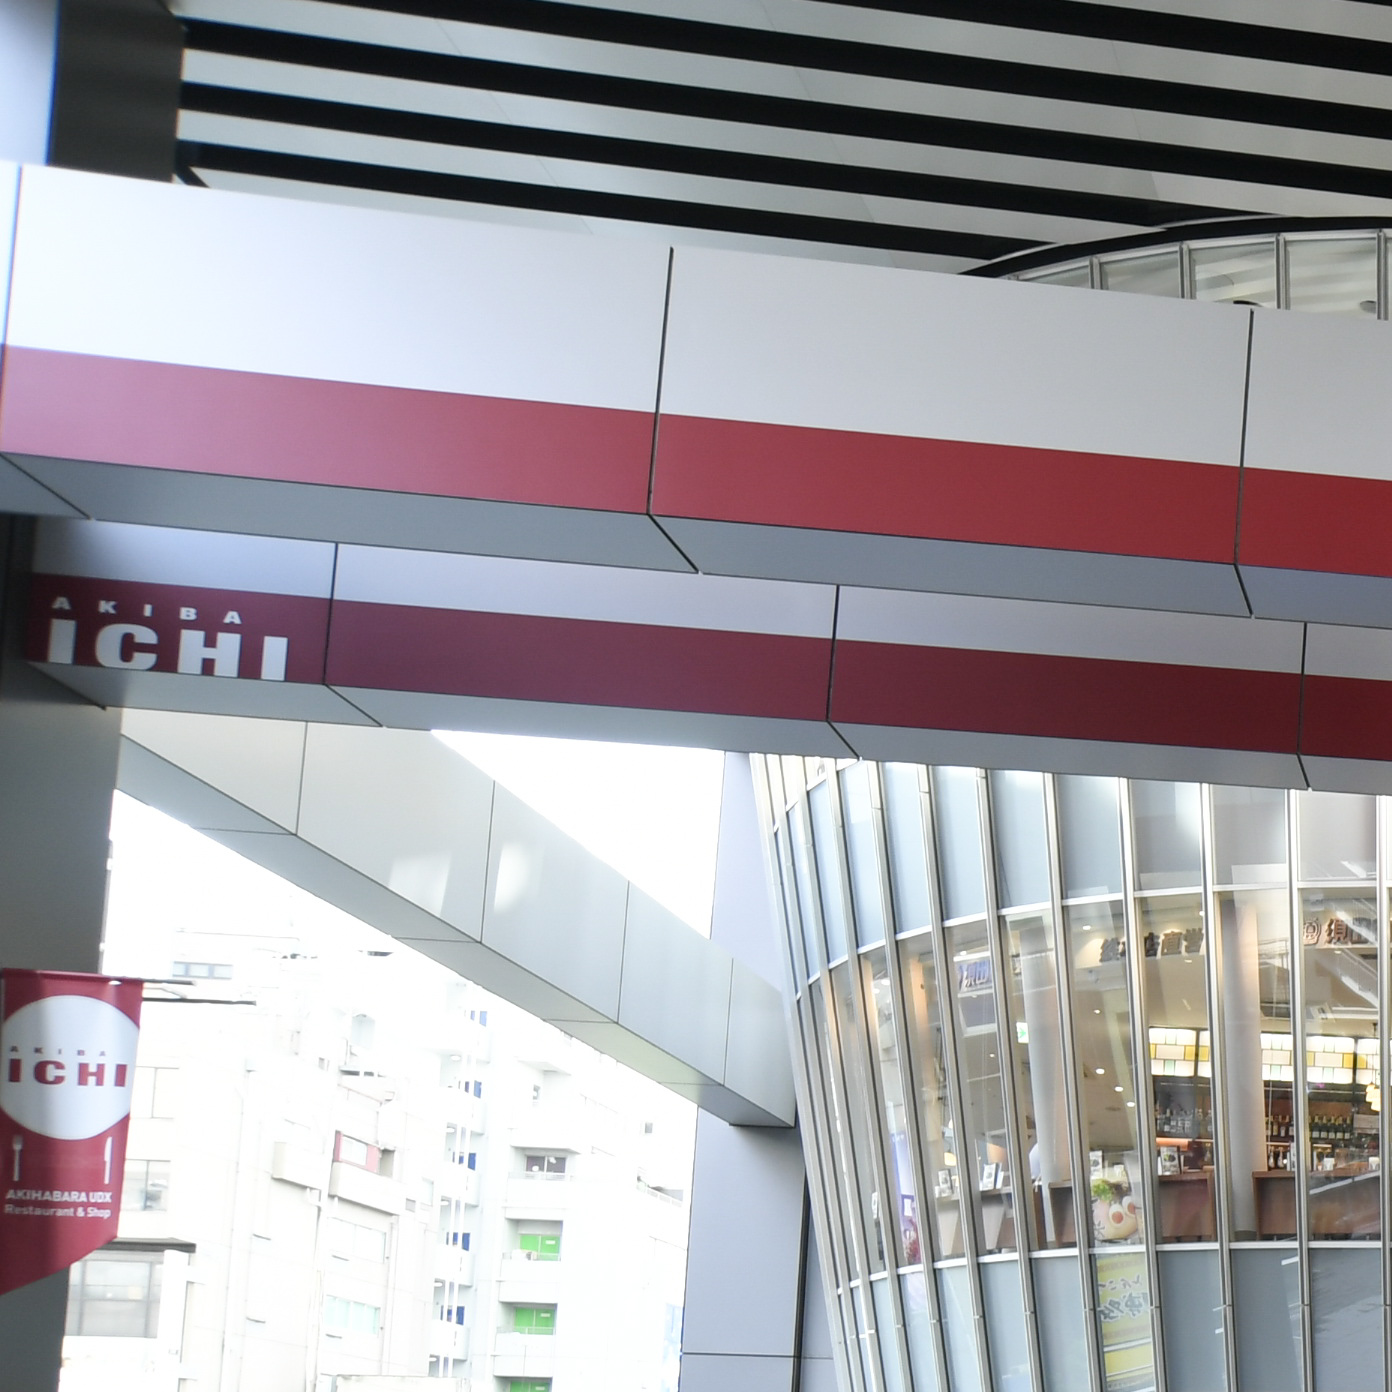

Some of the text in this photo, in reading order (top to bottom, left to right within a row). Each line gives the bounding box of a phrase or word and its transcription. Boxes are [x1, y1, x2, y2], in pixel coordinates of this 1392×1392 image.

[52, 596, 243, 625] AKIBA
[47, 618, 289, 681] ICHI
[10, 1045, 107, 1058] AKIBA
[8, 1058, 128, 1088] ICHI
[6, 1189, 113, 1204] AKIHABARA UDX
[4, 1203, 111, 1219] Restaurant & Shop
